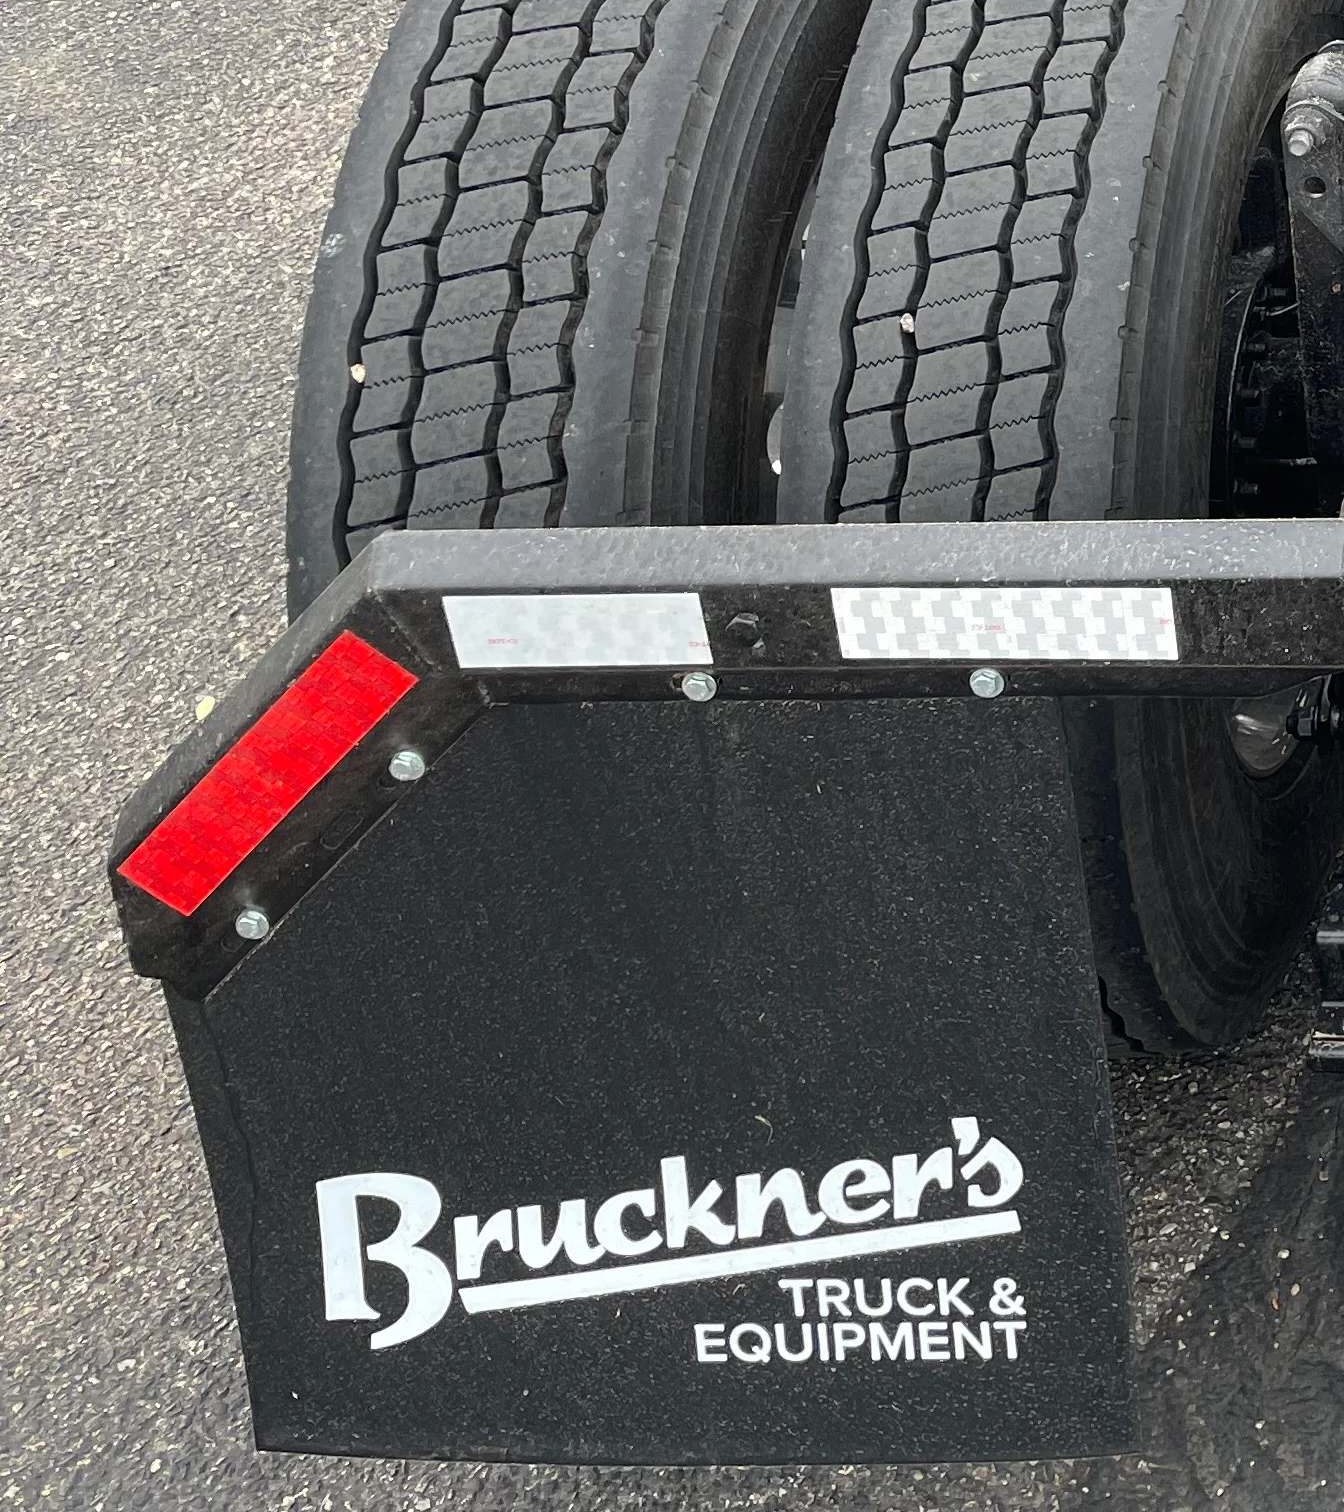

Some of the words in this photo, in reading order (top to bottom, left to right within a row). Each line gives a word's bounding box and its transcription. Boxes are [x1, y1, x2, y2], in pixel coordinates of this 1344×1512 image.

[315, 1116, 1024, 1350] Bruckner's
[777, 1278, 974, 1318] TRUCK
[988, 1277, 1027, 1317] &
[694, 1320, 1027, 1363] EQUIPMENT
